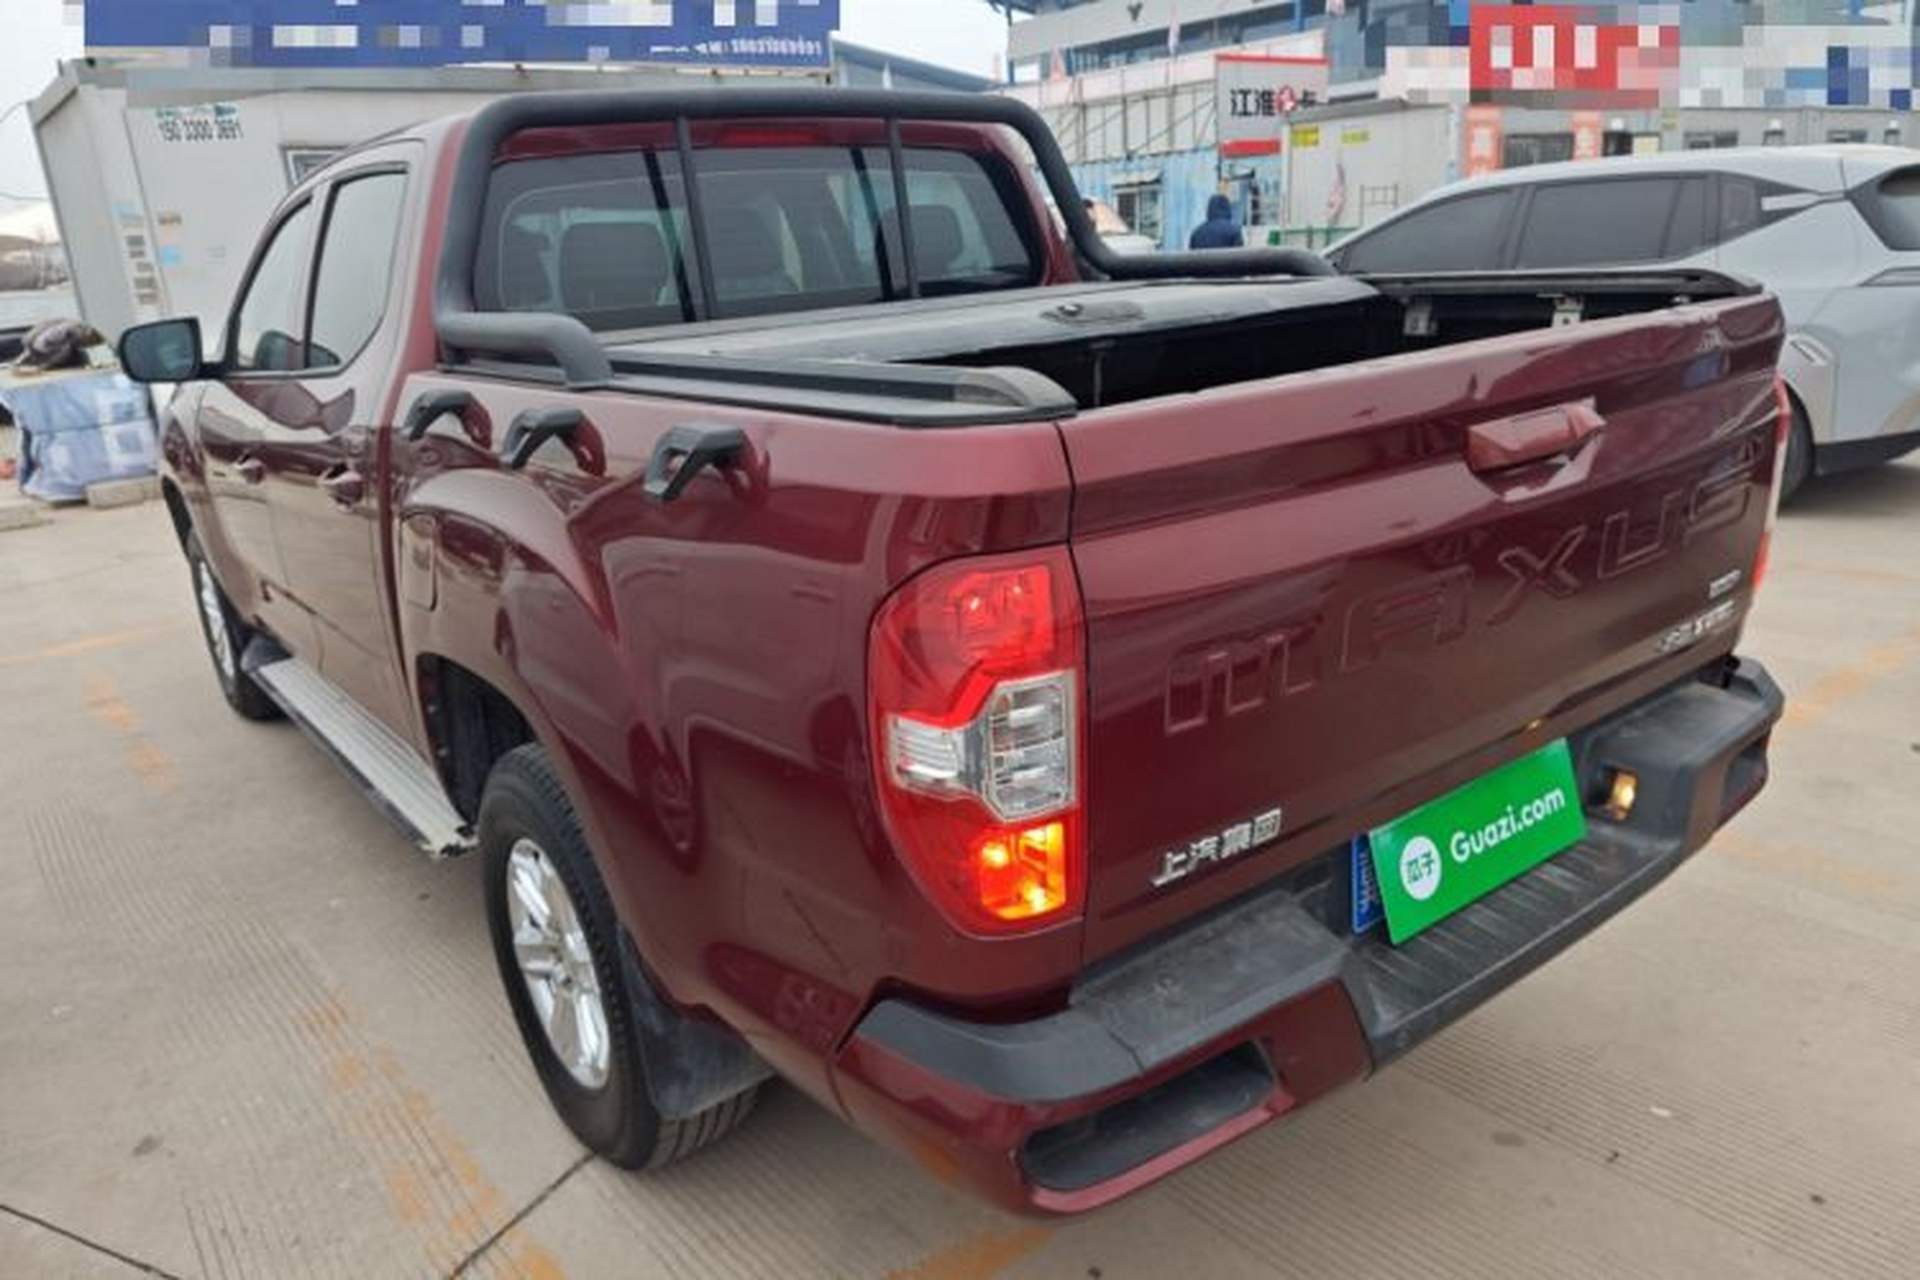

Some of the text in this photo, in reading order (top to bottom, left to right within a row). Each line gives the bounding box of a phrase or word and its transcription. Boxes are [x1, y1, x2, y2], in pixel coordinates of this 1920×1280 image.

[1164, 458, 1757, 735] MAXUS
[1153, 807, 1282, 886] 上汽集团
[1450, 788, 1566, 863] Guazi.com
[1406, 850, 1435, 885] 瓜子
